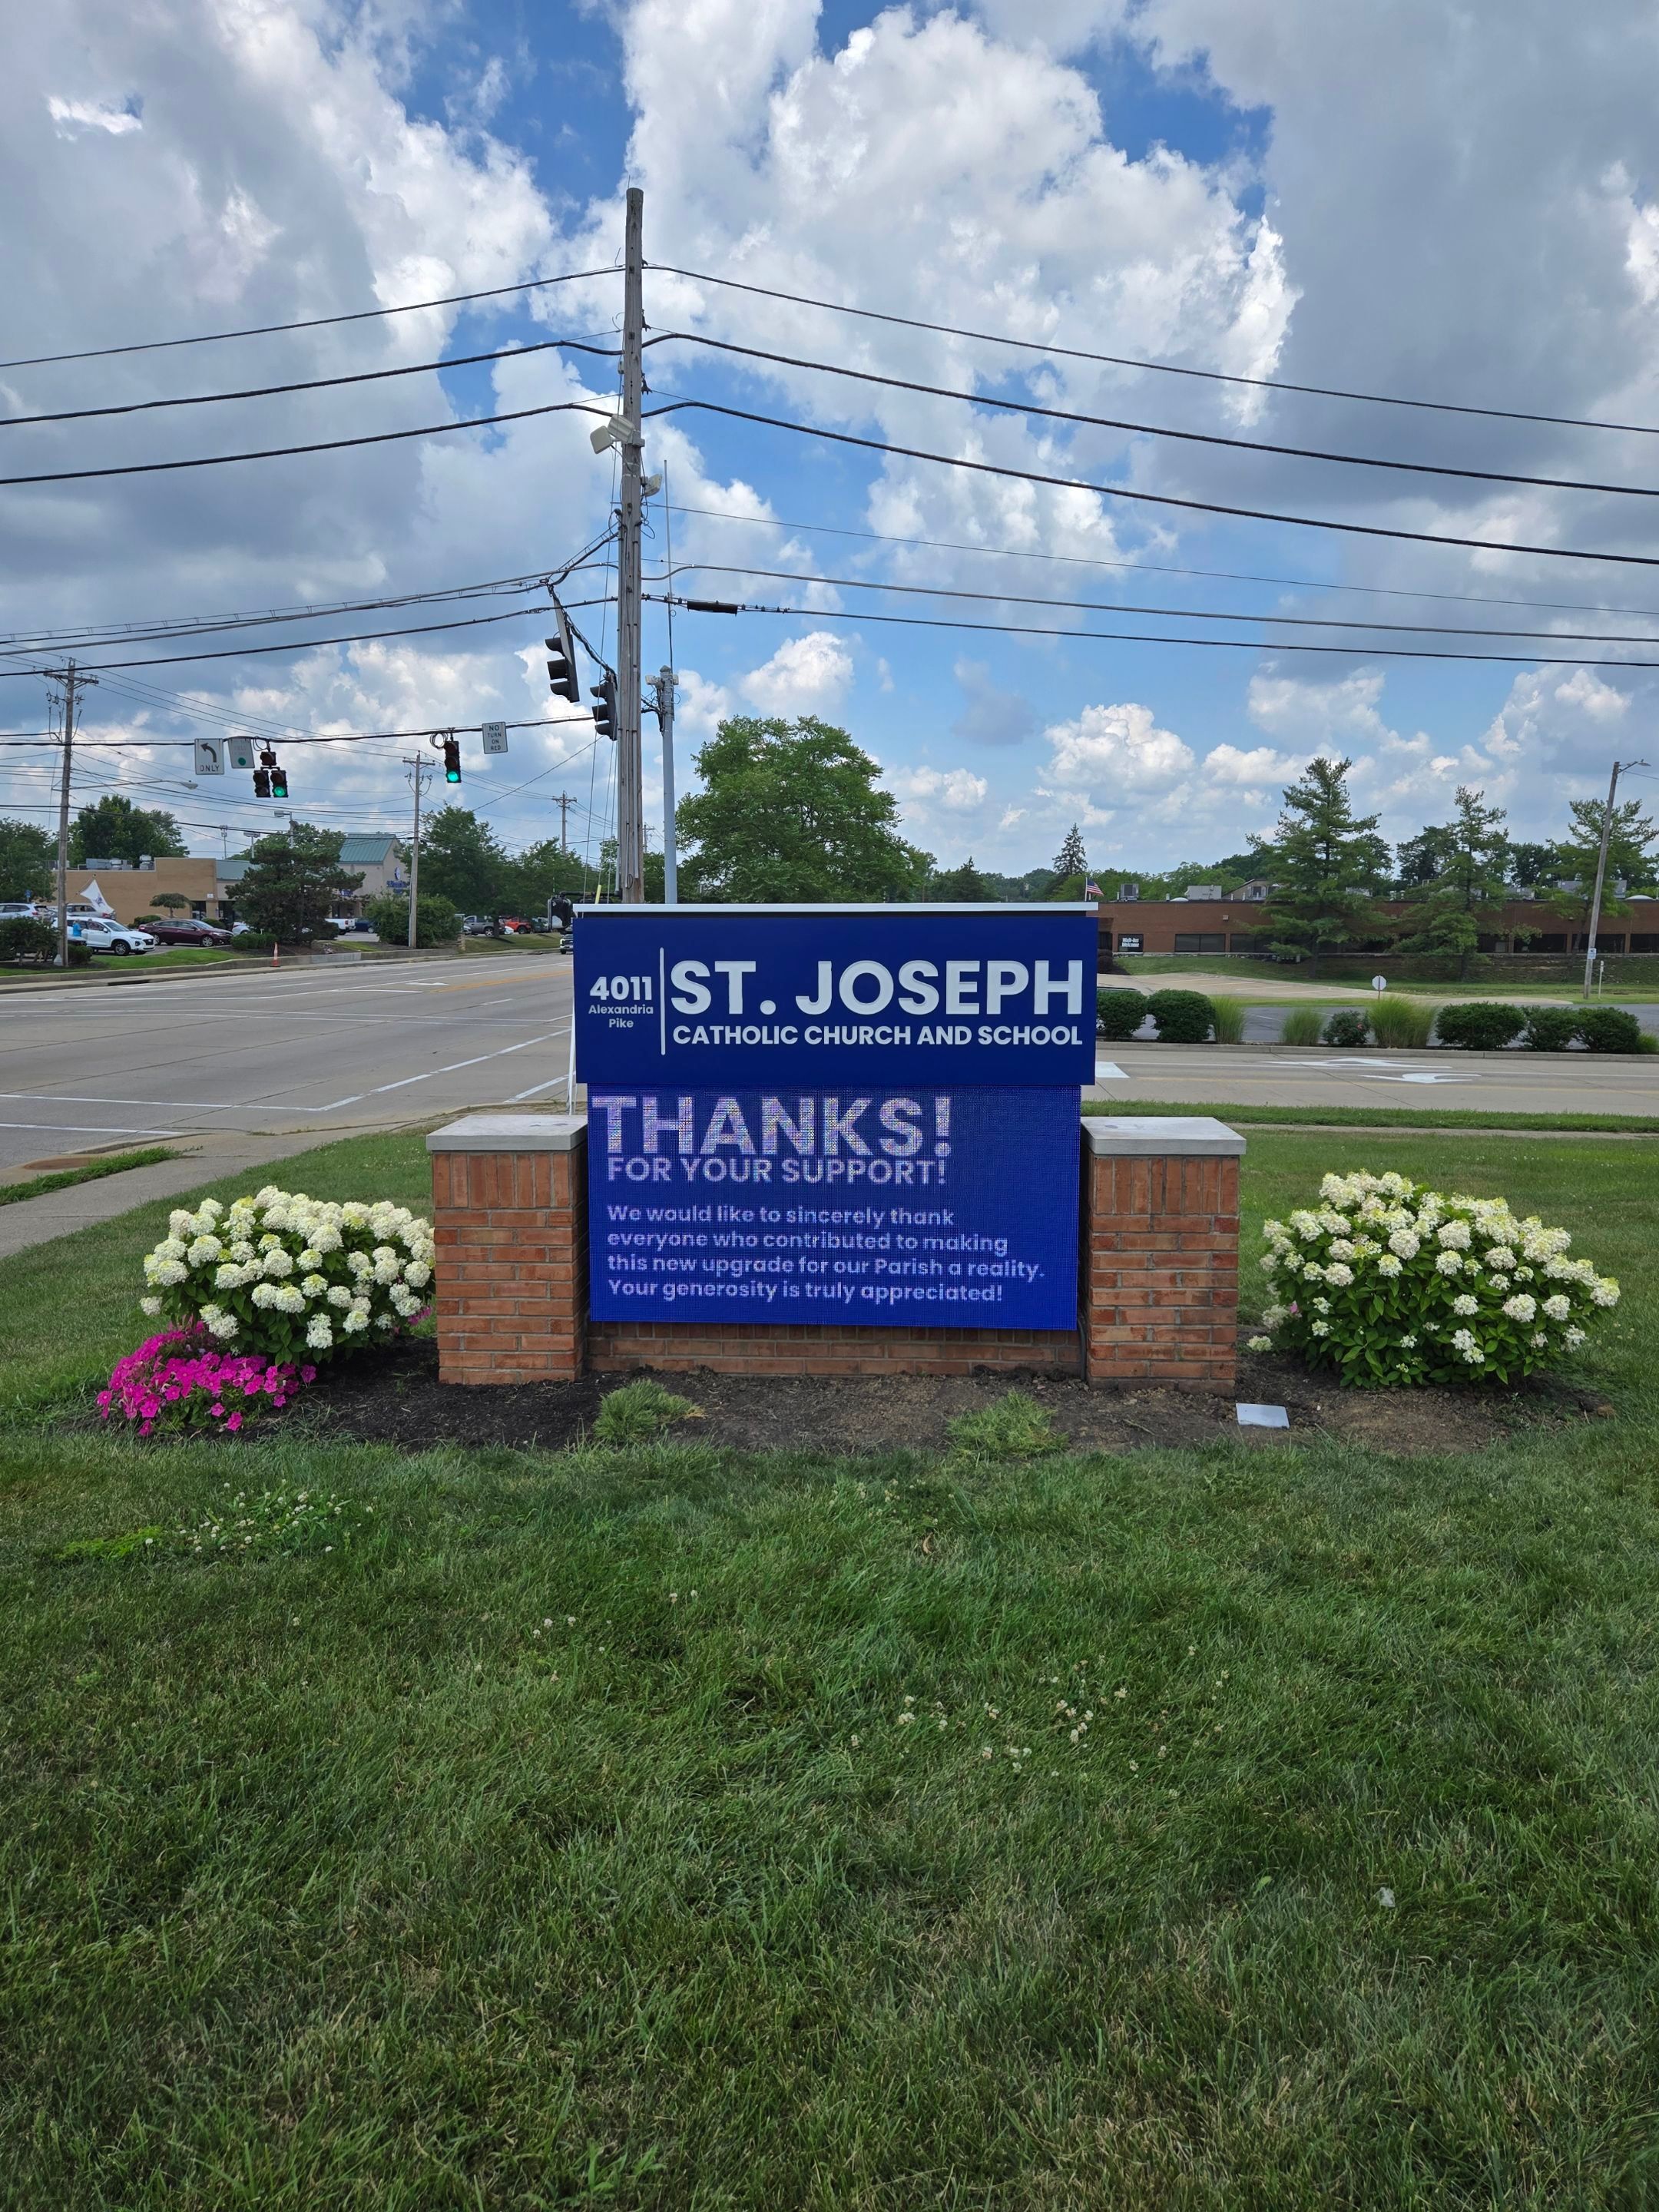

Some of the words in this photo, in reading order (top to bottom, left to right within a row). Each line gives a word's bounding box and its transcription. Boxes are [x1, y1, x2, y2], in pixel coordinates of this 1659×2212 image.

[589, 975, 652, 1001] 4011
[671, 960, 777, 1015] ST.
[796, 960, 1083, 1015] JOSEPH
[588, 1004, 654, 1015] Alexandria
[608, 1018, 634, 1028] Pike
[673, 1025, 798, 1045] CATHOLIC
[804, 1025, 911, 1045] CHURCH
[917, 1025, 972, 1045] AND
[978, 1025, 1083, 1045] SCHOOL
[591, 1096, 952, 1157] THANKS!
[608, 1157, 671, 1182] FOR
[680, 1157, 773, 1183] YOUR
[781, 1157, 946, 1185] SUPPORT!
[607, 1205, 641, 1221] We
[646, 1205, 712, 1222] would
[717, 1205, 754, 1222] like
[760, 1207, 781, 1223] to
[786, 1206, 885, 1229] sincerely
[890, 1208, 954, 1225] thank
[608, 1233, 707, 1251] everyone
[713, 1230, 758, 1247] who
[763, 1230, 891, 1249] contributed
[896, 1234, 919, 1250] to
[923, 1233, 1008, 1257] making
[608, 1254, 647, 1271] this
[653, 1258, 697, 1271] new
[702, 1256, 794, 1277] upgrade
[799, 1256, 829, 1273] for
[833, 1260, 869, 1274] our
[875, 1258, 942, 1276] Parish
[949, 1263, 961, 1276] a
[968, 1260, 1045, 1283] reality.
[608, 1280, 659, 1296] Your
[663, 1280, 777, 1303] generosity
[783, 1280, 800, 1298] is
[805, 1281, 856, 1304] truly
[861, 1283, 1002, 1305] appreciated!
